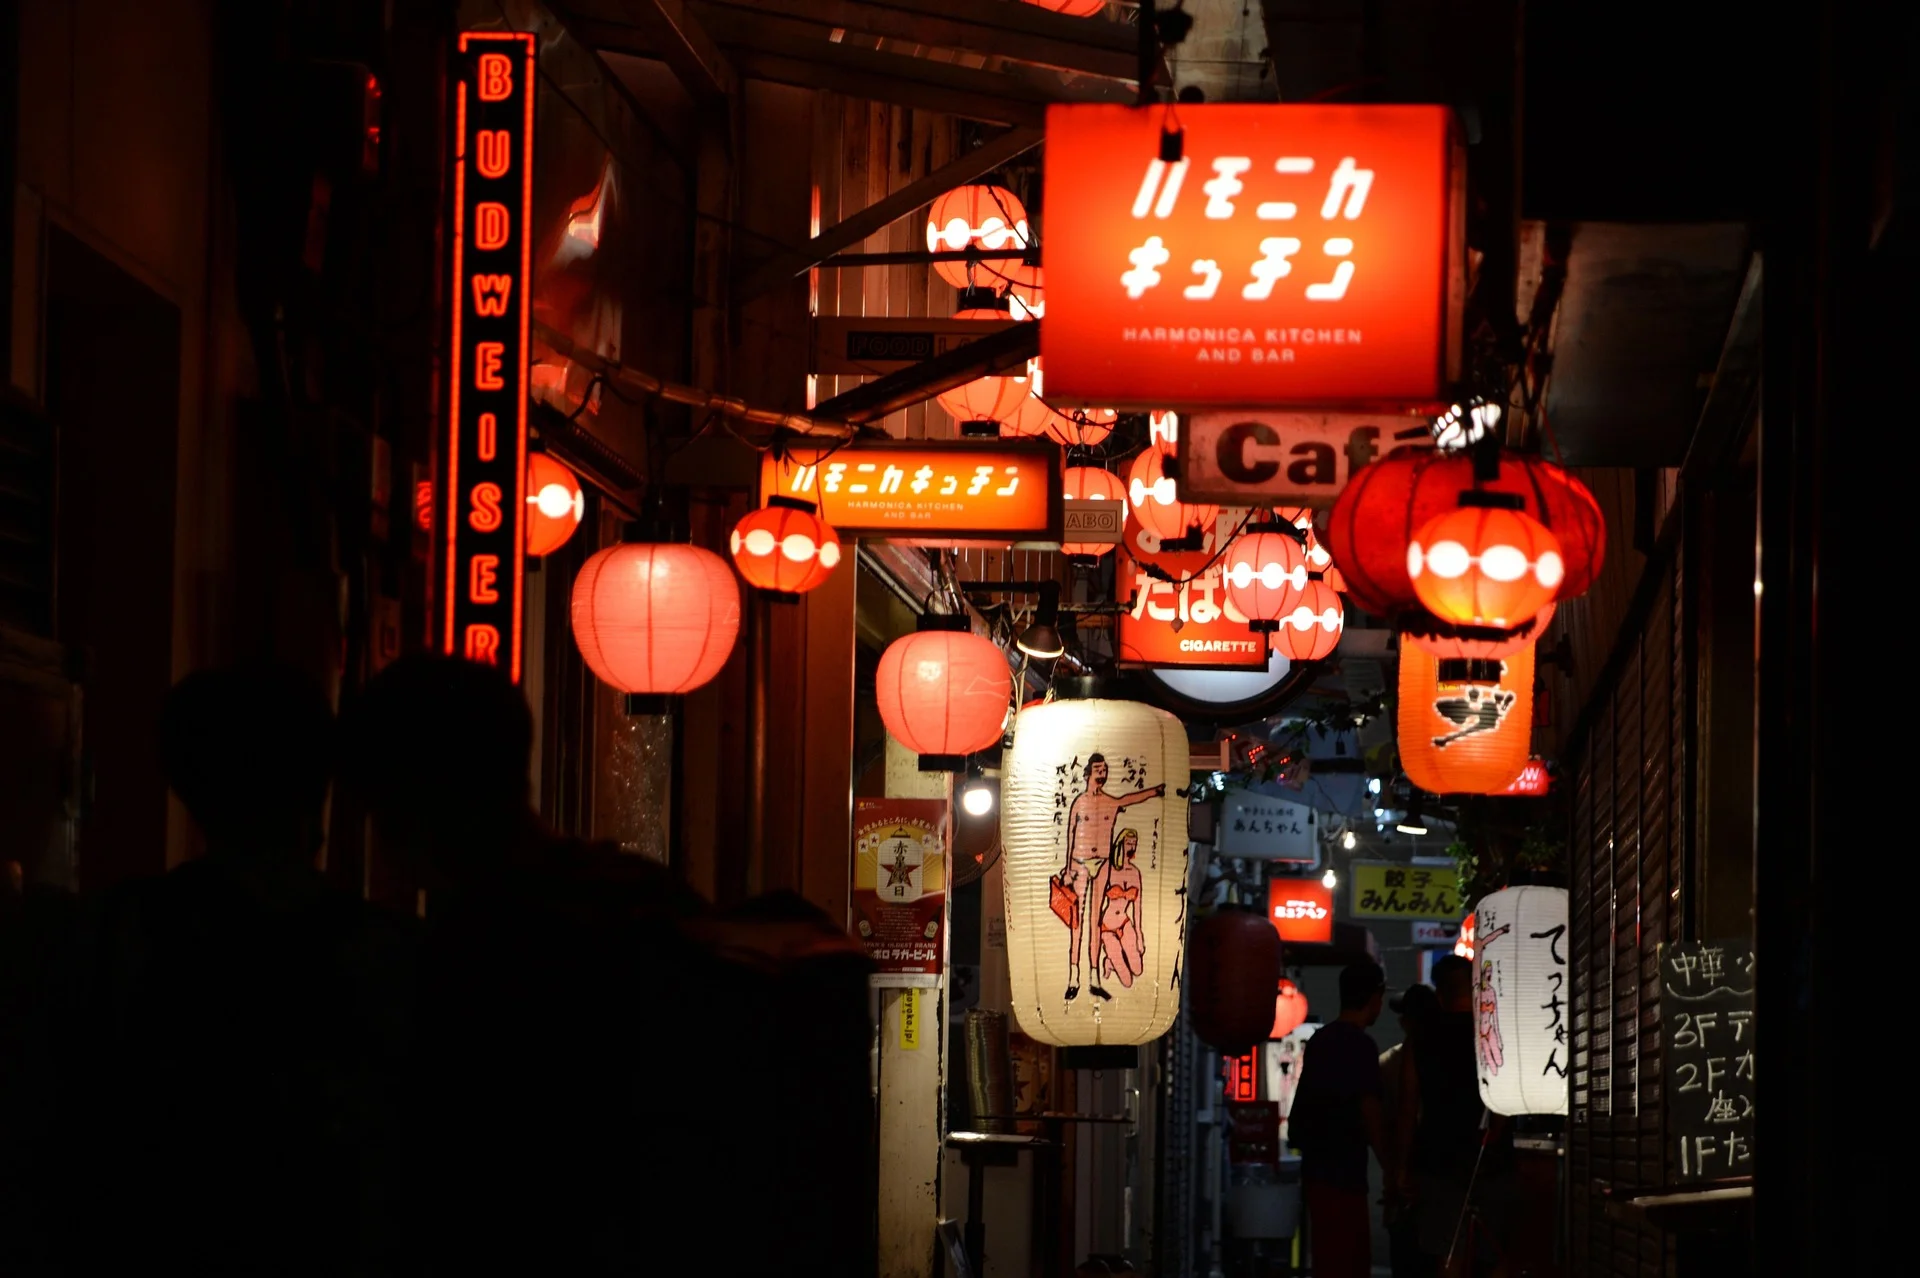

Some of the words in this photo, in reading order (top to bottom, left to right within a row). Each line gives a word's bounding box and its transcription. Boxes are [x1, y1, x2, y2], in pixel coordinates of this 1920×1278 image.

[1131, 157, 1375, 220] ハモニカ
[1121, 236, 1355, 300] キッチン
[1123, 328, 1256, 343] HARMONICA
[1265, 329, 1362, 343] KITCHEN
[463, 53, 514, 663] BUDWEISER
[1197, 348, 1241, 362] AND
[1252, 349, 1295, 362] BAR
[1216, 421, 1432, 486] Caf
[791, 463, 1020, 496] ハモニカキッチン
[848, 501, 912, 510] HARMONICA
[917, 502, 964, 511] KITCHEN
[884, 511, 905, 519] AND
[1179, 639, 1257, 653] CIGARETTE
[1233, 818, 1302, 835] あんちゃん
[1359, 889, 1455, 915] みんみん
[1530, 924, 1568, 1079] てっちゃん
[1673, 1011, 1717, 1049] 3F
[1675, 1056, 1726, 1094] 2F
[1681, 1135, 1716, 1176] 1F
